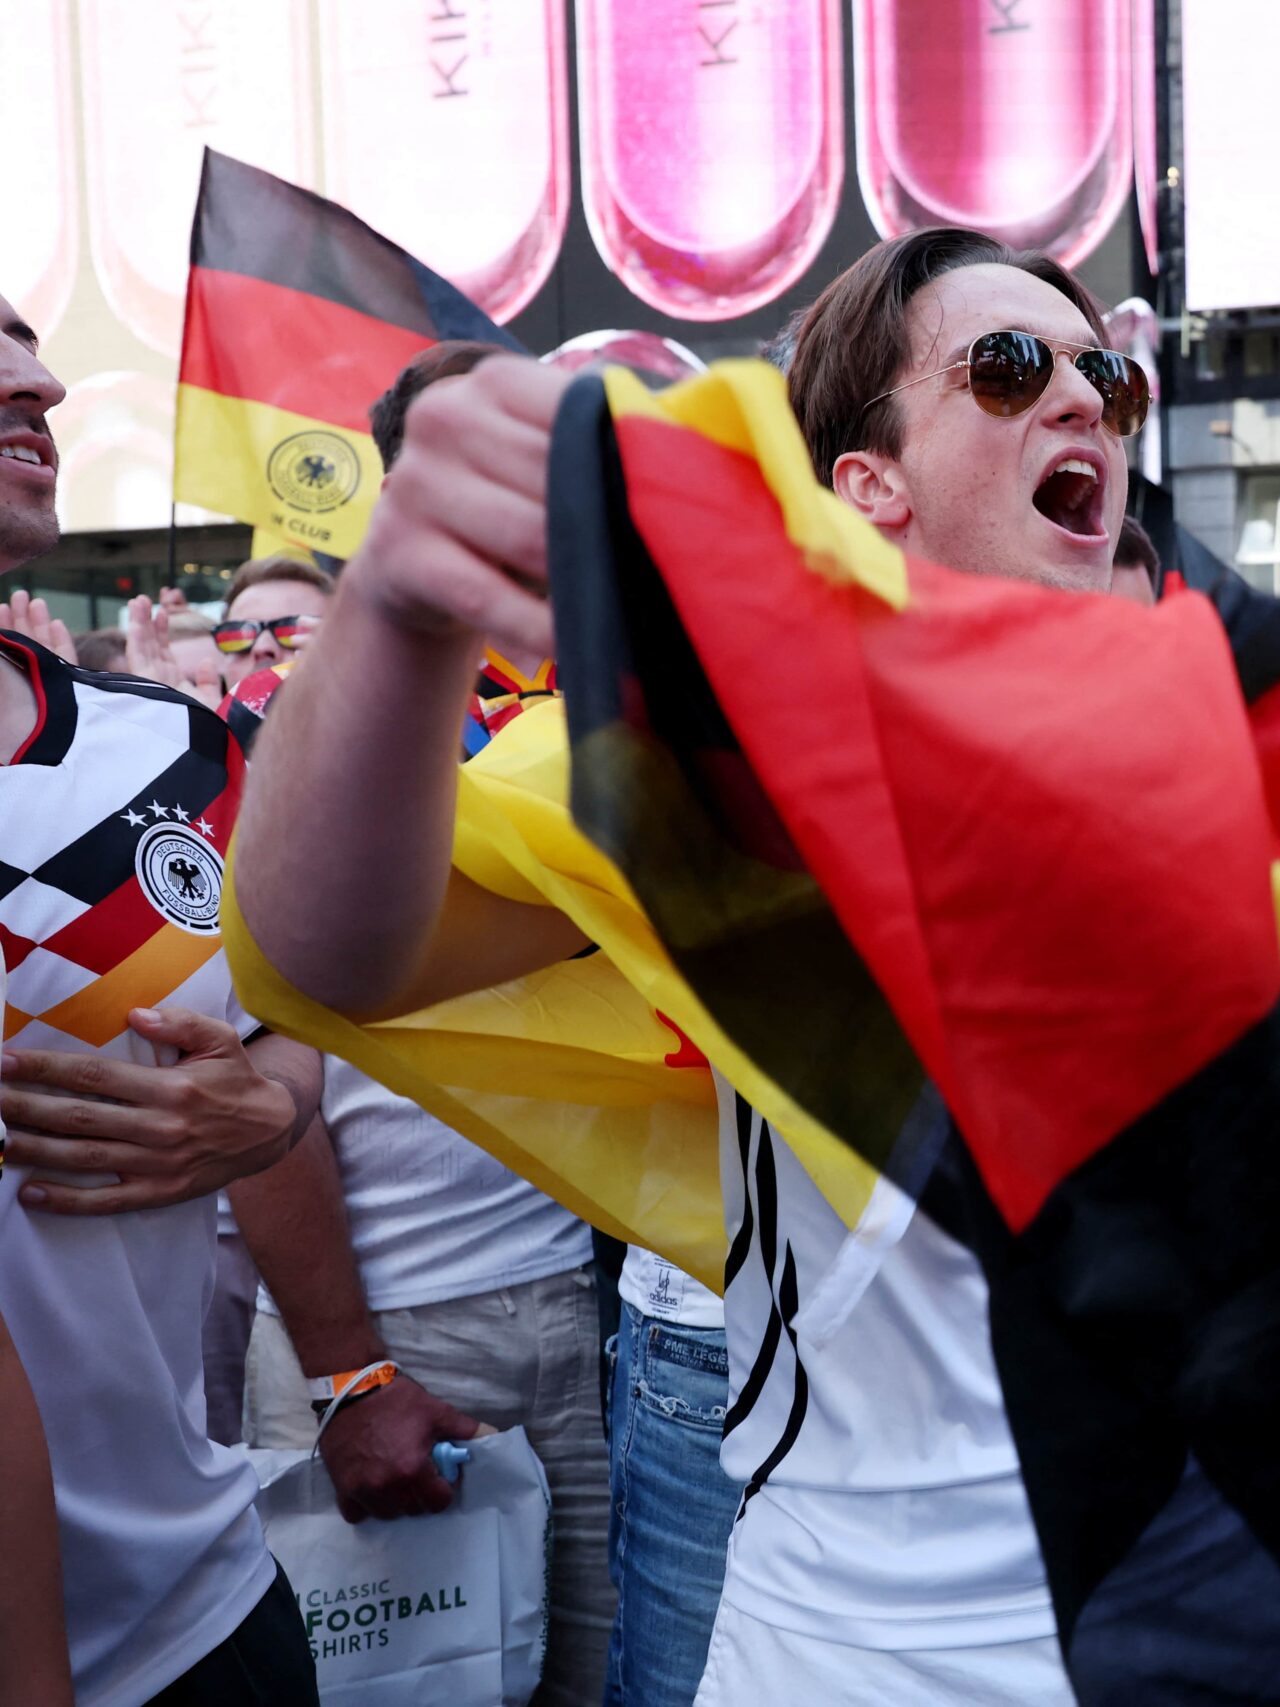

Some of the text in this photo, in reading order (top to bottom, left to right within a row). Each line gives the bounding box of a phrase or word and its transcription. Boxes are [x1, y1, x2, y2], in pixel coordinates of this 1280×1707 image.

[177, 0, 217, 128] KIK
[288, 518, 331, 541] CLUB
[156, 842, 204, 863] DEUTSCHER
[162, 889, 220, 918] FUSSBALL-BUND
[649, 1290, 678, 1307] adidas
[692, 1345, 728, 1365] LEGE
[306, 1585, 467, 1638] FOOTBALL
